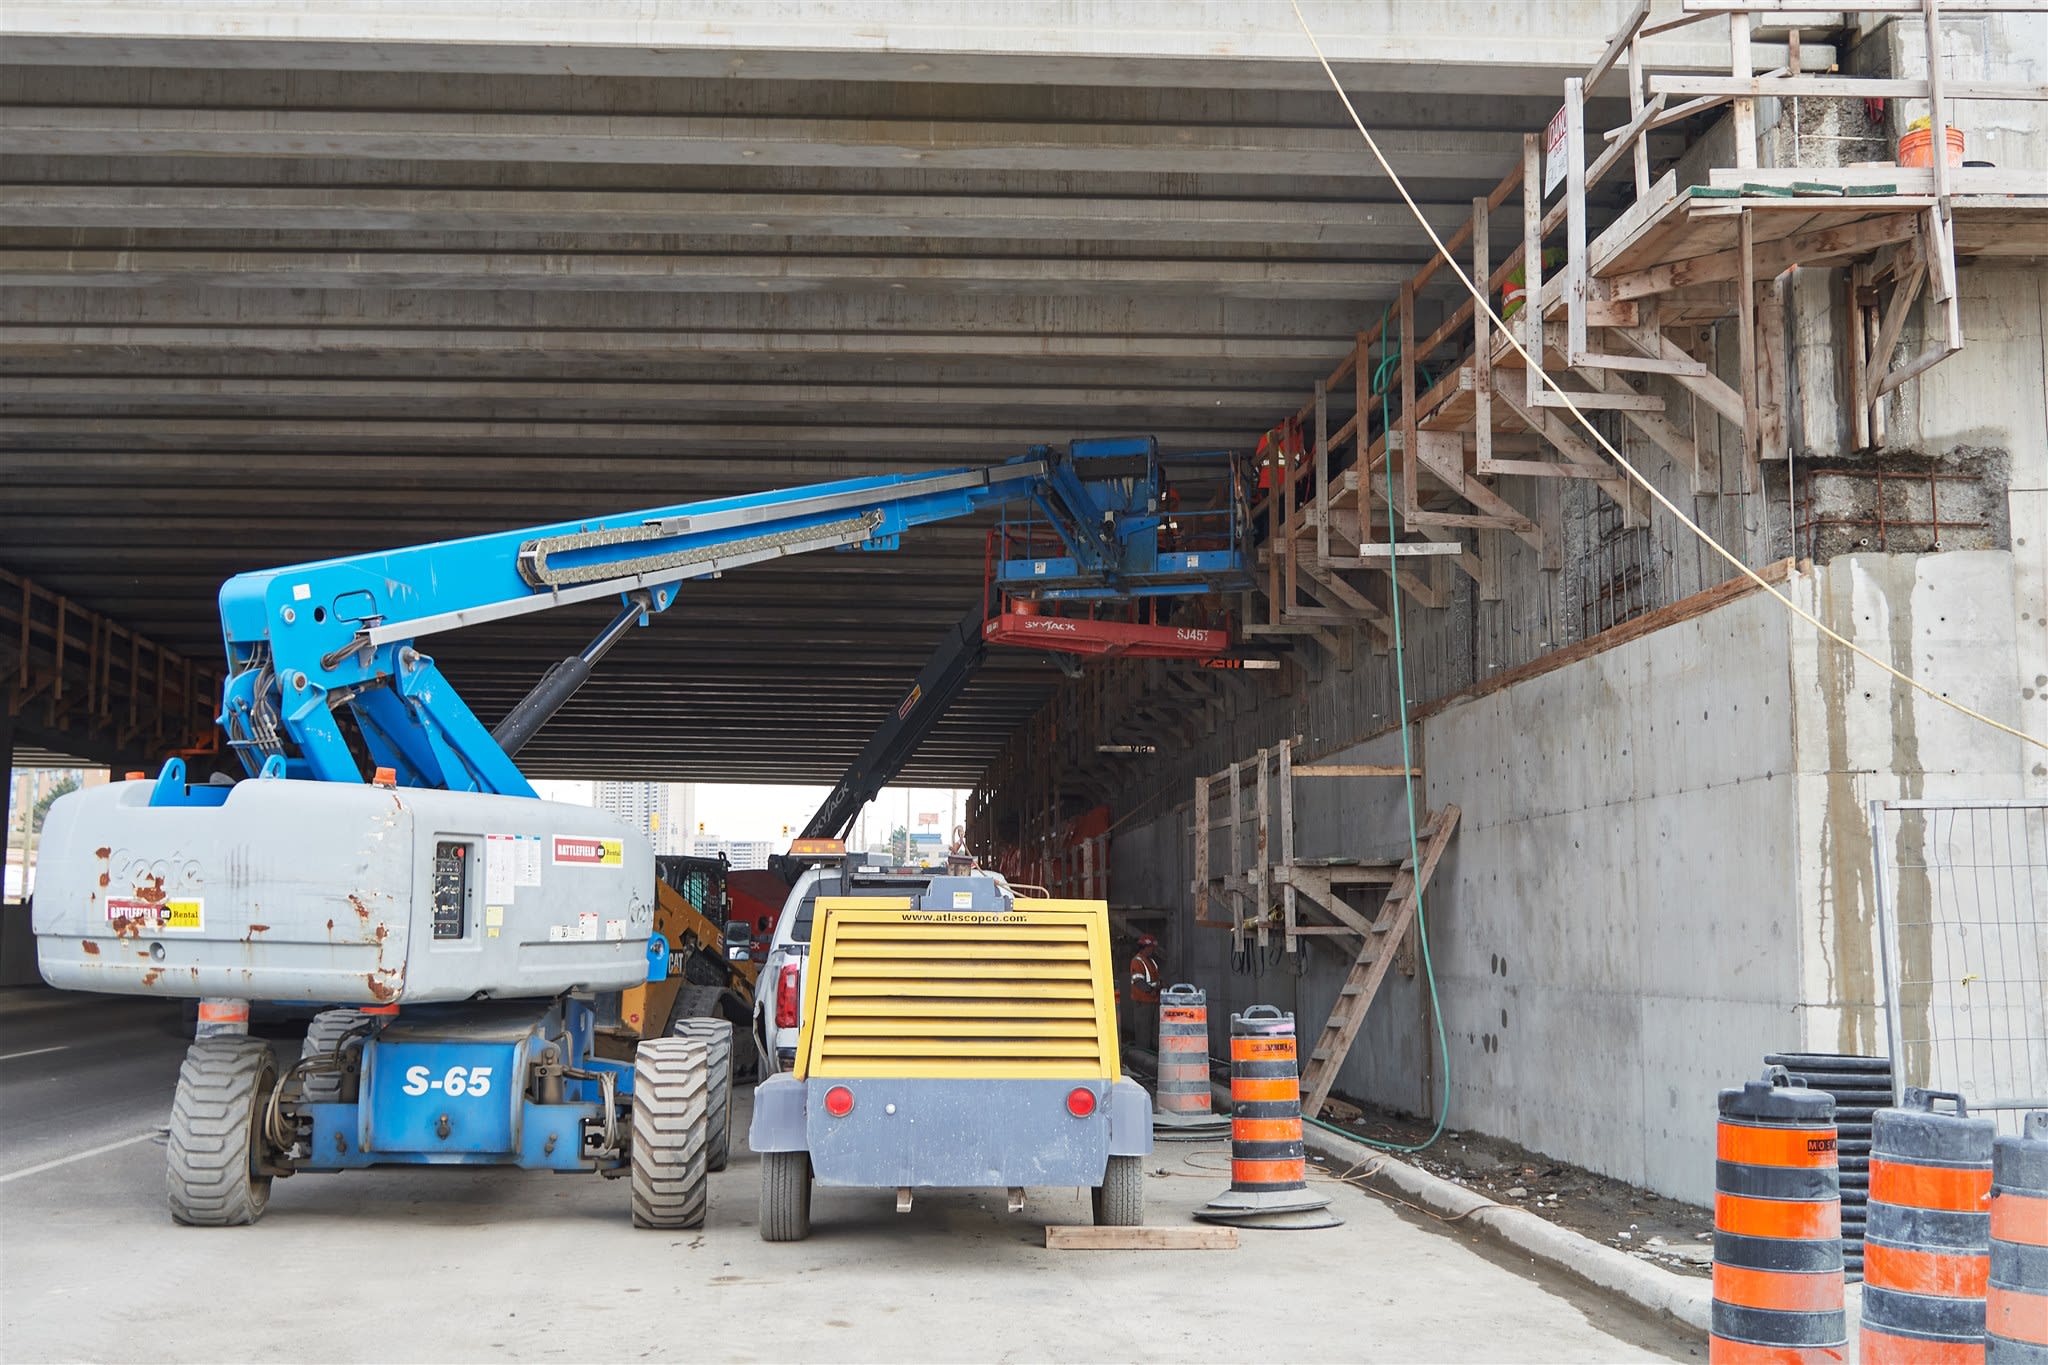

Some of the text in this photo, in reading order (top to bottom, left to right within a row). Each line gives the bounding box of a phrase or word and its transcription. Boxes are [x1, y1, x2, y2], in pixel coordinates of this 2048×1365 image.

[1025, 620, 1076, 631] SKYJACK
[1177, 628, 1208, 640] SJ45T
[558, 844, 596, 857] BATTLEFIELD
[173, 911, 199, 919] Rental
[902, 912, 1028, 924] www.atlascopco.com
[669, 952, 684, 975] CAT
[402, 1065, 493, 1097] S-65
